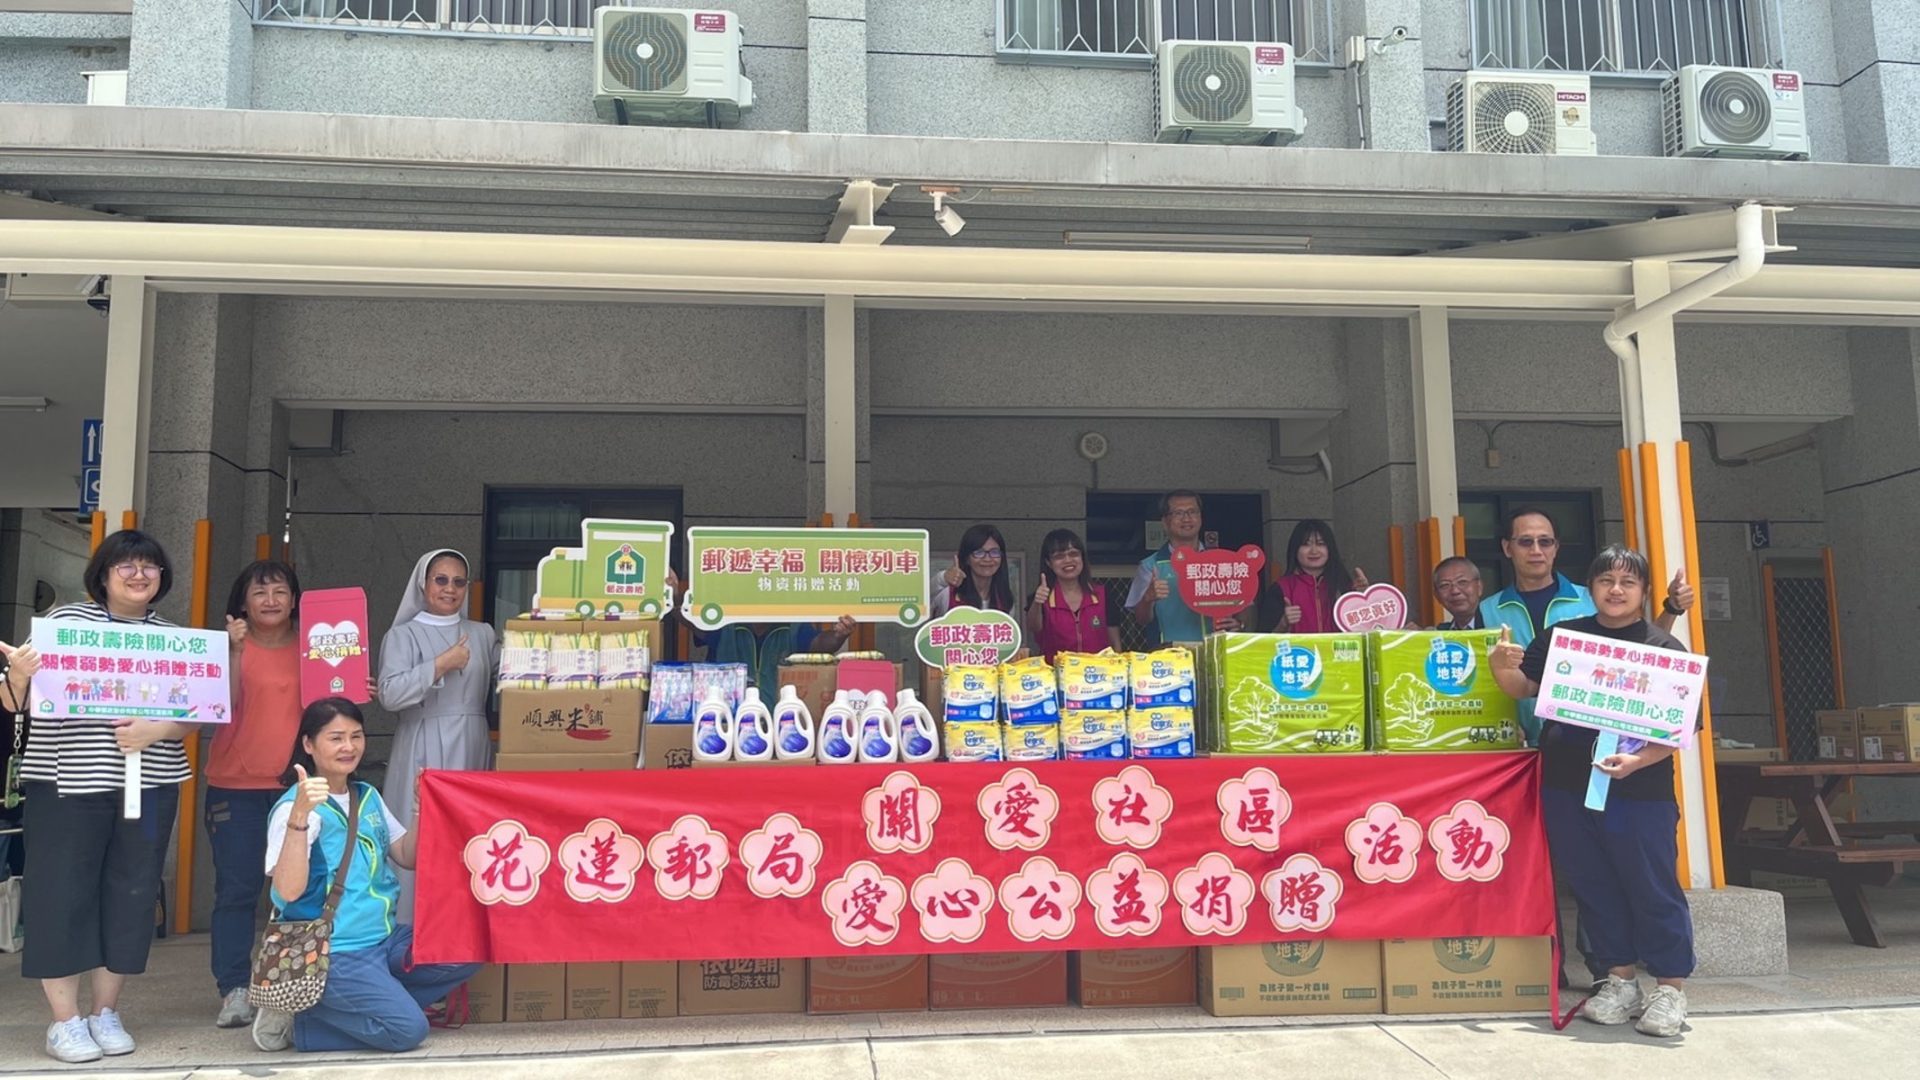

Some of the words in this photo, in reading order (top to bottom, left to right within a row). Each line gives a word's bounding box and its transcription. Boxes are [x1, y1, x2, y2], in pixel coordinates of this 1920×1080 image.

[1558, 93, 1586, 101] HITACHI
[702, 549, 805, 574] 郵遞幸福
[820, 549, 919, 574] 關懷列車
[1186, 562, 1249, 579] 郵政壽險
[758, 577, 860, 591] 物資捐贈活動
[1195, 580, 1242, 596] 關心您
[57, 628, 207, 654] 郵政壽險關心您
[930, 623, 1013, 645] 郵政壽險
[40, 653, 222, 679] 關懷弱勢愛心捐贈活動
[945, 647, 998, 665] 關心您
[1554, 635, 1702, 676] 關懷弱勢愛心捐贈活動
[1551, 683, 1684, 726] 郵政壽險關心您
[878, 782, 1274, 844] 關愛社區
[1364, 819, 1494, 871] 活動
[481, 831, 804, 892] 花蓮郵局
[843, 868, 1325, 932] 愛心公益捐贈
